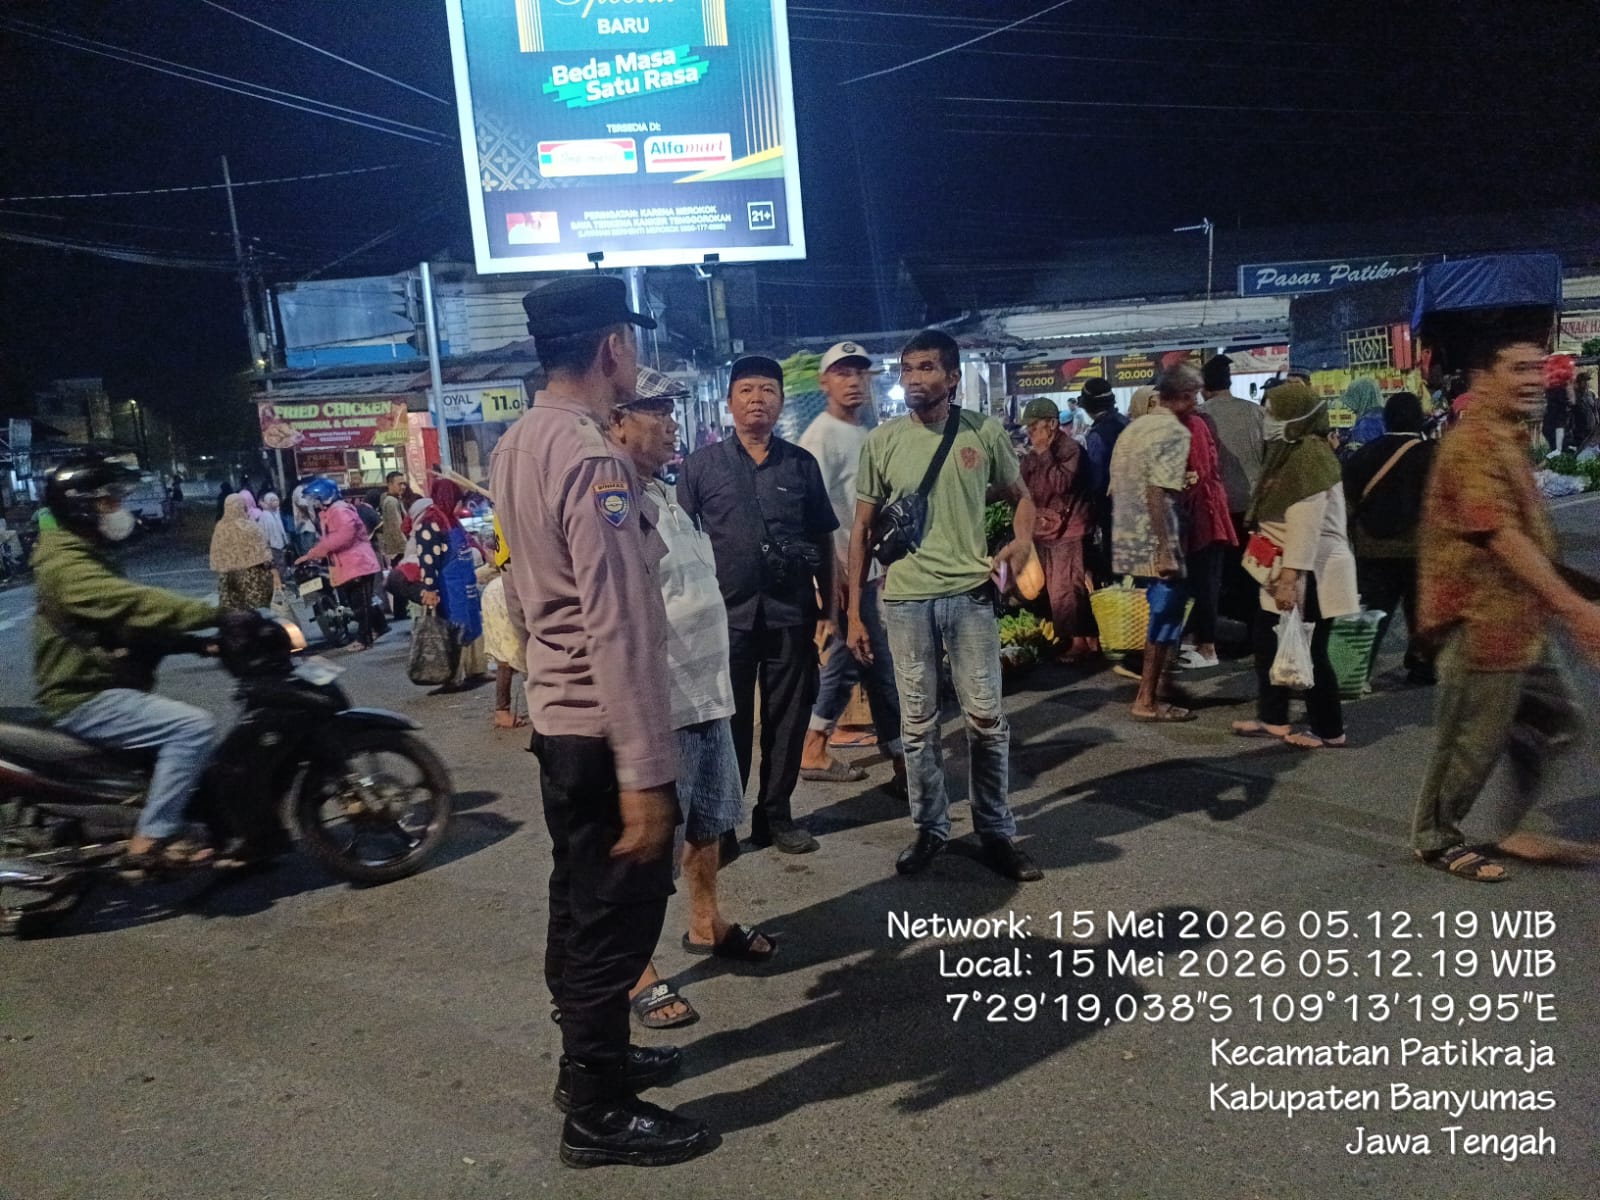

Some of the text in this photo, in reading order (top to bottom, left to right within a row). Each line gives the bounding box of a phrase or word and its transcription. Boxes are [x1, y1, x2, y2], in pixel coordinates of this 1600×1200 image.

[597, 17, 649, 35] BARU
[552, 48, 677, 86] Beda Masa
[586, 65, 699, 102] Satu Rasa
[650, 140, 723, 155] Alfamart
[751, 209, 771, 223] 21+
[1256, 268, 1321, 290] Pasar
[1018, 376, 1054, 388] 20.000
[1118, 369, 1153, 381] 20.000
[443, 394, 472, 406] OYAL
[273, 400, 392, 420] FRIED CHICKEN
